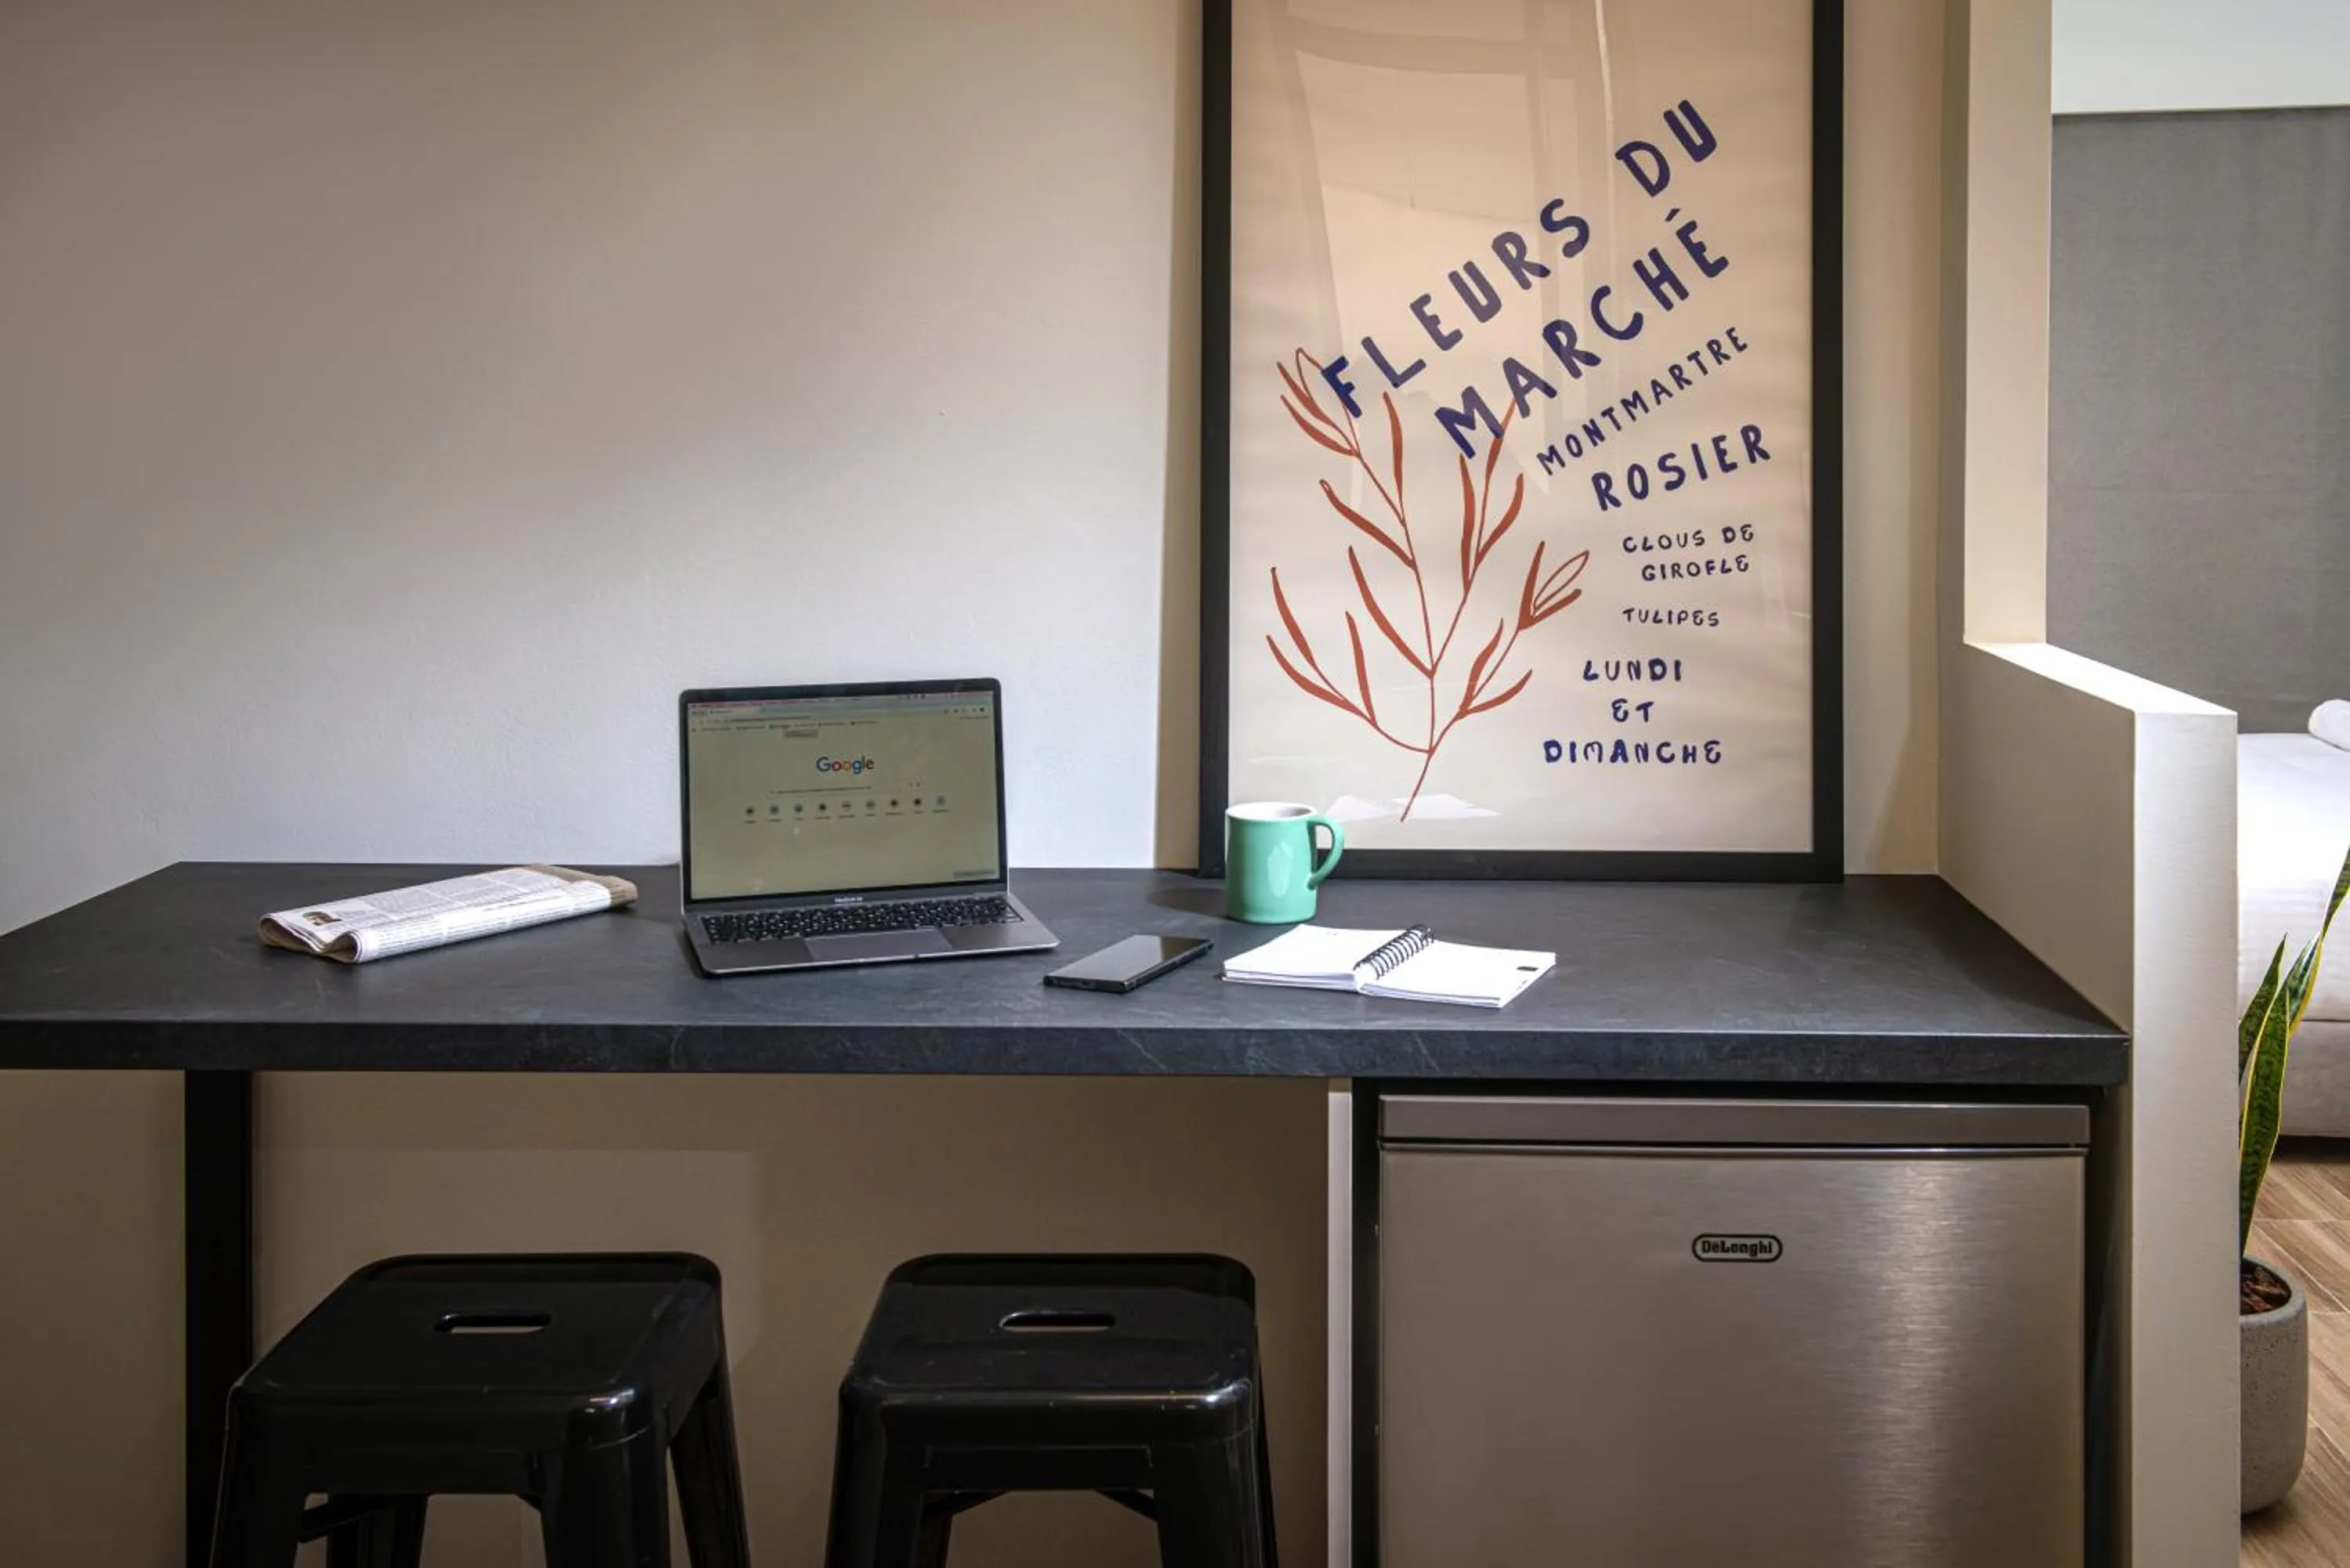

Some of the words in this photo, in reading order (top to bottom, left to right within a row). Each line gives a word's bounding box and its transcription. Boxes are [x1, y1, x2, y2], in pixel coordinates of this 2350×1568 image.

[1320, 199, 1590, 419] FLEURS
[1614, 99, 1717, 197] DU
[1434, 208, 1729, 460] MARCHÉ
[1536, 327, 1748, 476] MONTMARTRE
[1591, 424, 1771, 511] ROSIER
[1622, 529, 1706, 553] CLOUS
[1721, 524, 1754, 544] DE
[1641, 555, 1749, 582] GIROFLE
[1622, 607, 1720, 627] TULIPES
[1582, 657, 1683, 682] LUNDI
[1611, 698, 1654, 723] ET
[815, 755, 875, 775] Google
[1542, 739, 1723, 764] DIMANCHE
